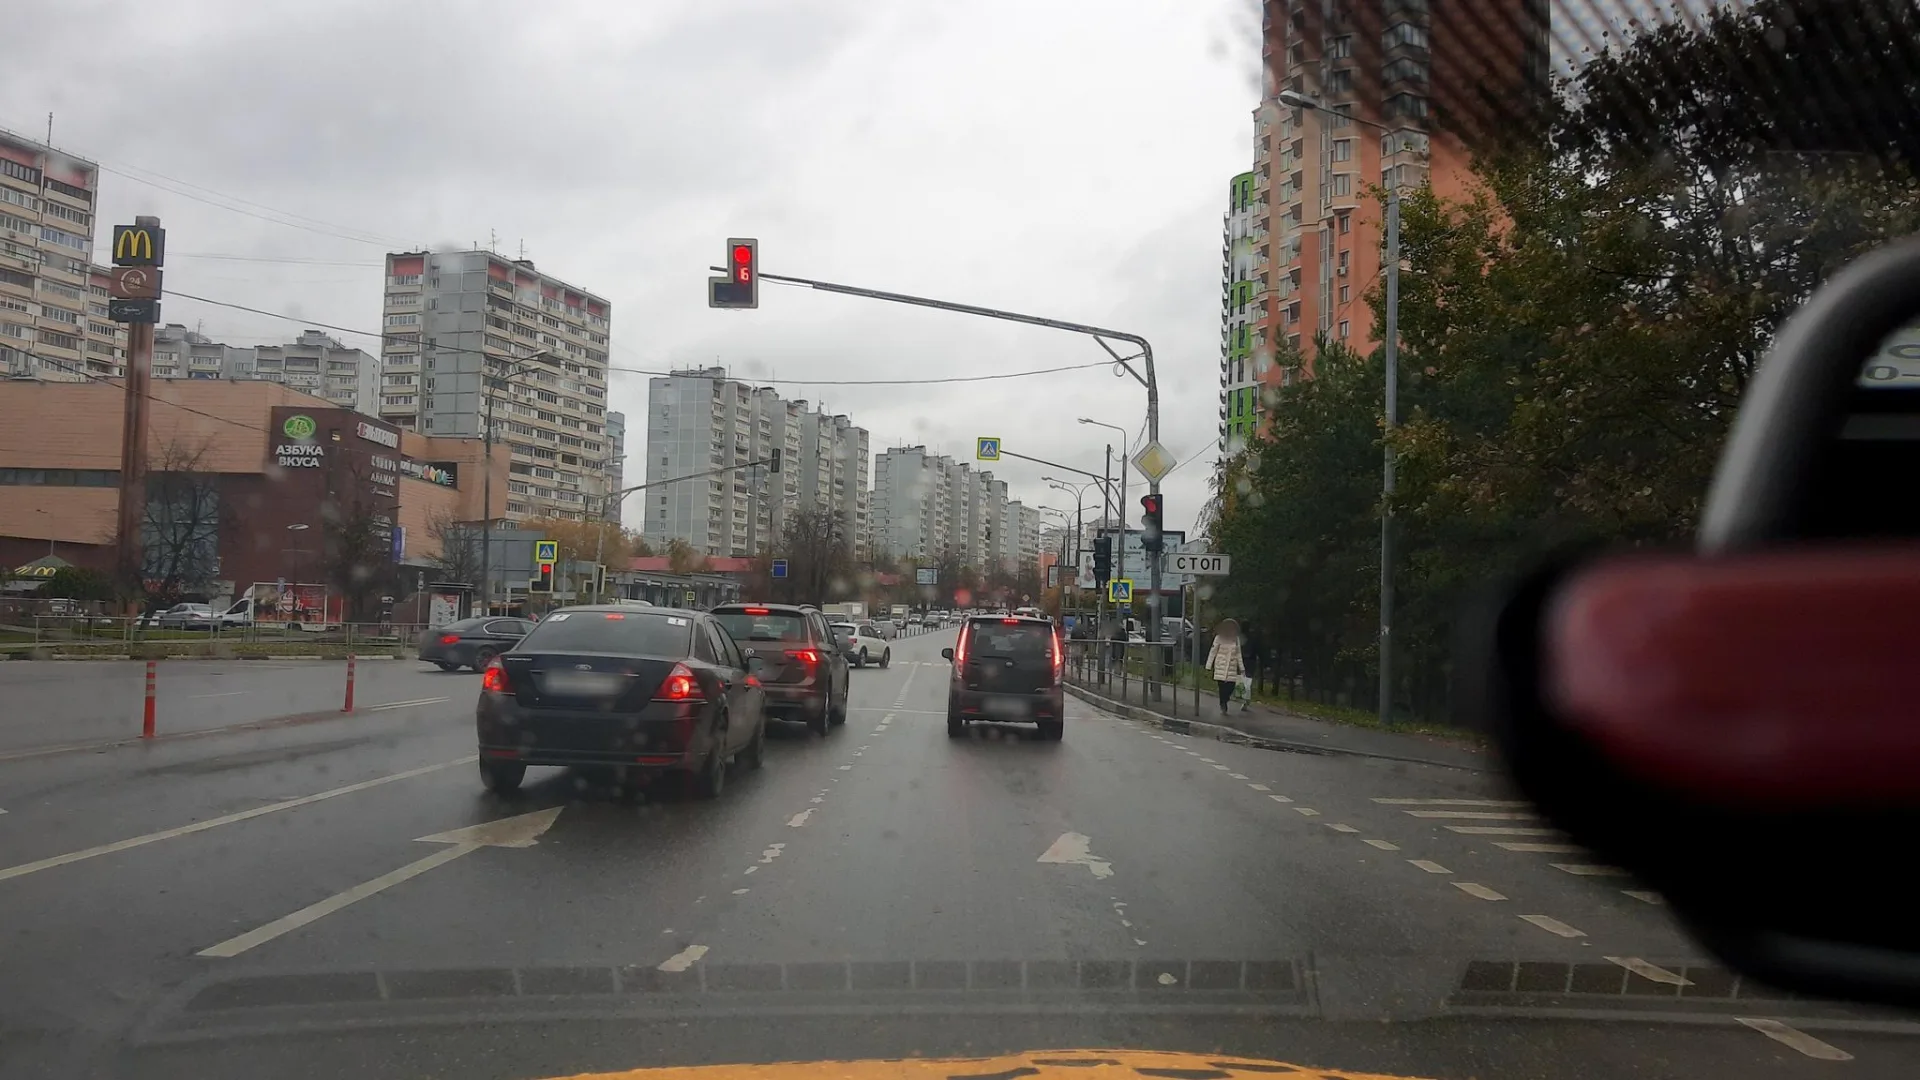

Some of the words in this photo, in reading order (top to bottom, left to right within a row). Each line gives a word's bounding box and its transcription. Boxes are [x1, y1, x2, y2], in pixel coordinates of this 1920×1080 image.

[739, 267, 750, 281] 6
[275, 444, 324, 456] АЗБУКА
[279, 456, 320, 467] ВКУСА
[1176, 557, 1221, 571] СТОП
